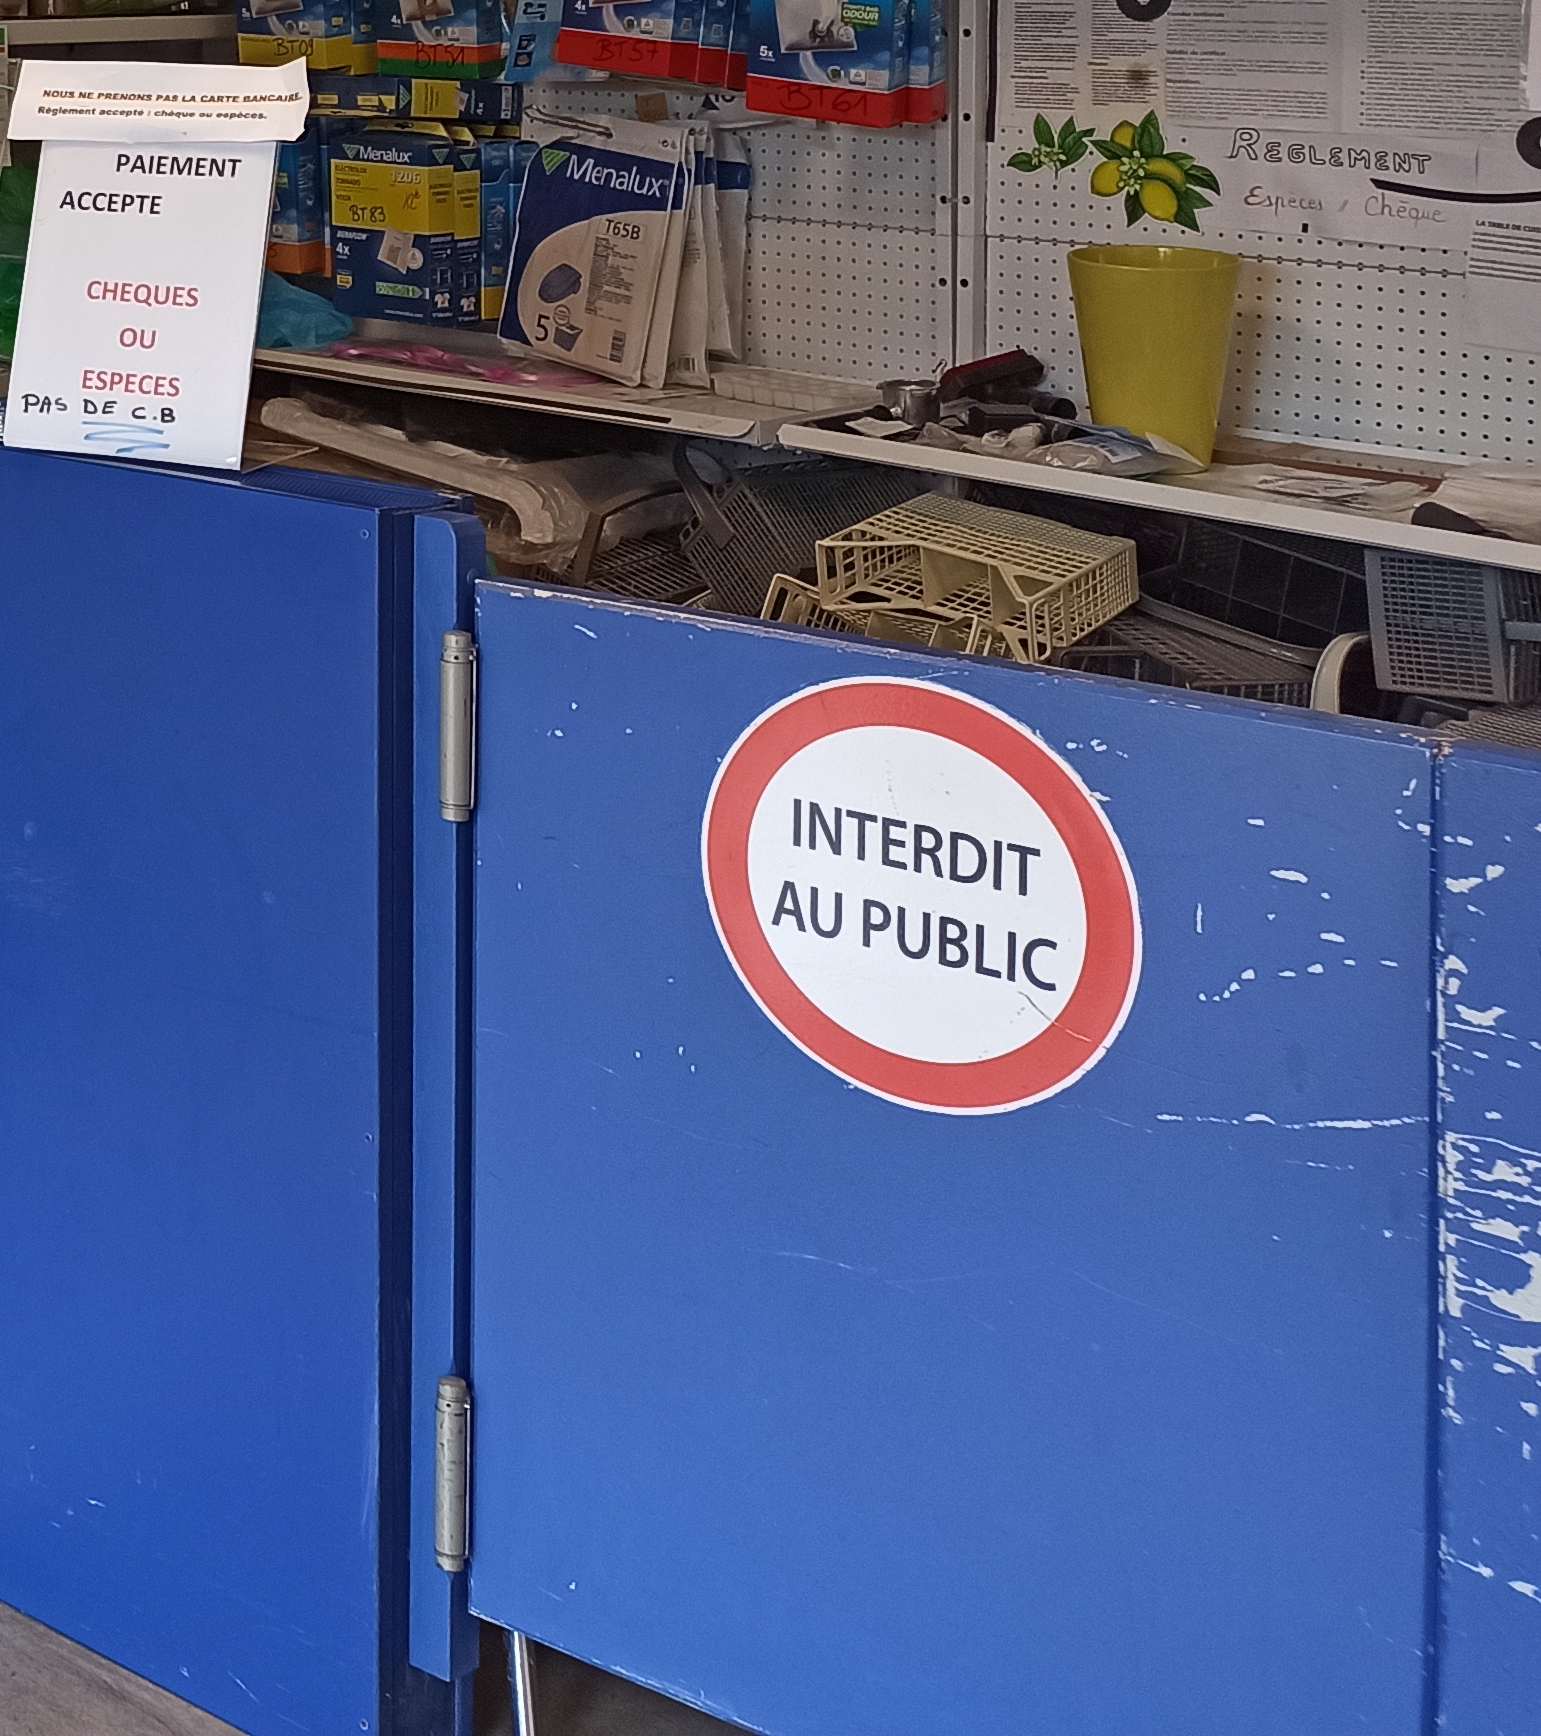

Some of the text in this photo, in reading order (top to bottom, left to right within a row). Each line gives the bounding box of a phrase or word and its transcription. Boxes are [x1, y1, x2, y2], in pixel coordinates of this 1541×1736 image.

[43, 90, 75, 98] NOUS
[97, 92, 152, 101] PRENONS
[156, 94, 178, 102] PAS
[182, 95, 196, 103] LA
[200, 95, 239, 103] CARTE
[38, 107, 96, 116] Règlement
[99, 108, 144, 117] accepté
[154, 109, 195, 119] chèque
[216, 112, 267, 120] espèces.
[1228, 128, 1432, 175] REGLEMENT
[116, 153, 242, 178] PAIEMENT
[568, 156, 664, 198] Menalux
[59, 190, 162, 215] ACCEPTE
[349, 206, 386, 222] BT 83
[605, 219, 641, 240] T65B
[87, 281, 199, 307] CHEQUES
[119, 327, 157, 349] OU
[82, 370, 180, 397] ESPECES
[21, 393, 176, 423] PAS DE C.B
[793, 798, 1041, 896] INTERDIT
[772, 880, 1058, 991] AU PUBLIC
